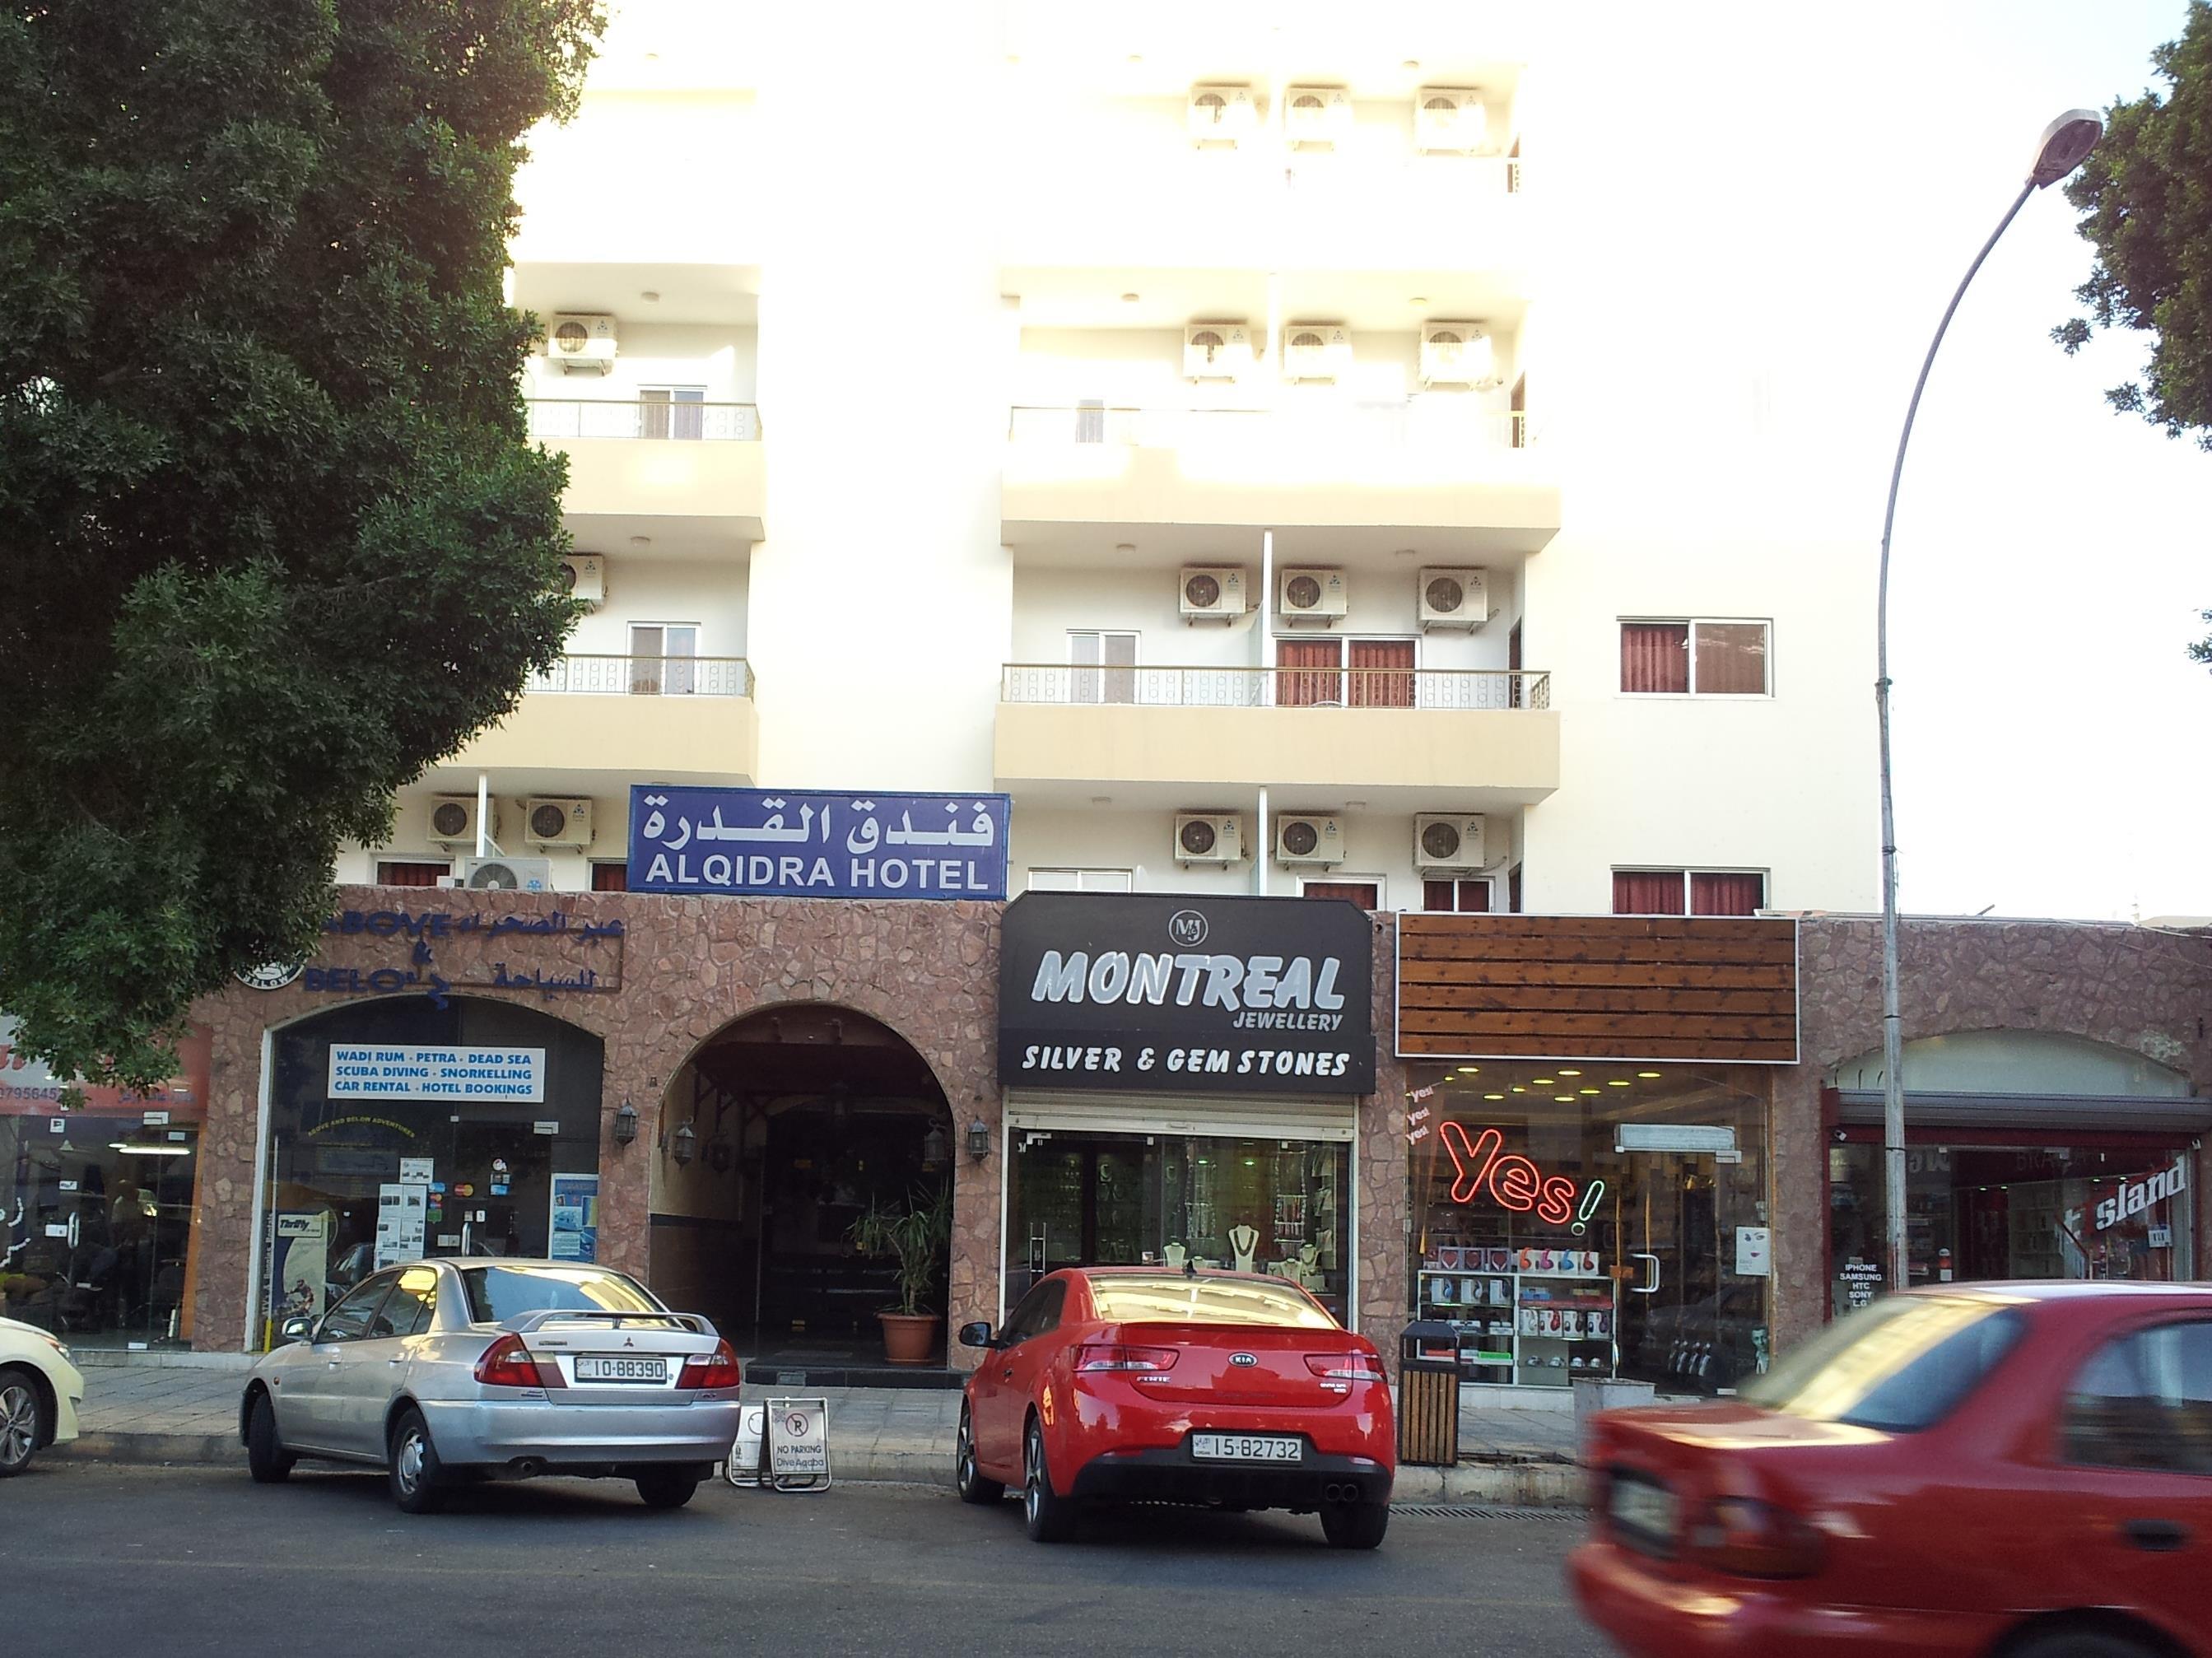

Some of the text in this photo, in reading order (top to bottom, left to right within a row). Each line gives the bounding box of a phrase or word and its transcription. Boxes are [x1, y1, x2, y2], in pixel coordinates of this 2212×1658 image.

[643, 794, 994, 855] فندق القدرة
[645, 853, 990, 890] ALQIDRA HOTEL
[1031, 950, 1345, 1012] MONTREAL
[1233, 1011, 1343, 1032] JEWELLERY
[337, 1051, 531, 1064] WADI RUM PETRA DEAD SEA
[1022, 1046, 1350, 1076] SILVER & GEM STONES
[336, 1066, 532, 1079] SCUBA DIVING SNORKELLING
[334, 1081, 533, 1094] CAR RENTAL HOTEL BOOKINGS
[1439, 1121, 1605, 1237] Yes!
[1845, 1264, 1877, 1272] IPHONE
[1839, 1273, 1882, 1281] SAMSUNG
[1852, 1282, 1870, 1290] HTC
[776, 1445, 822, 1454] NO PARKING
[1215, 1437, 1298, 1459] 15-82732
